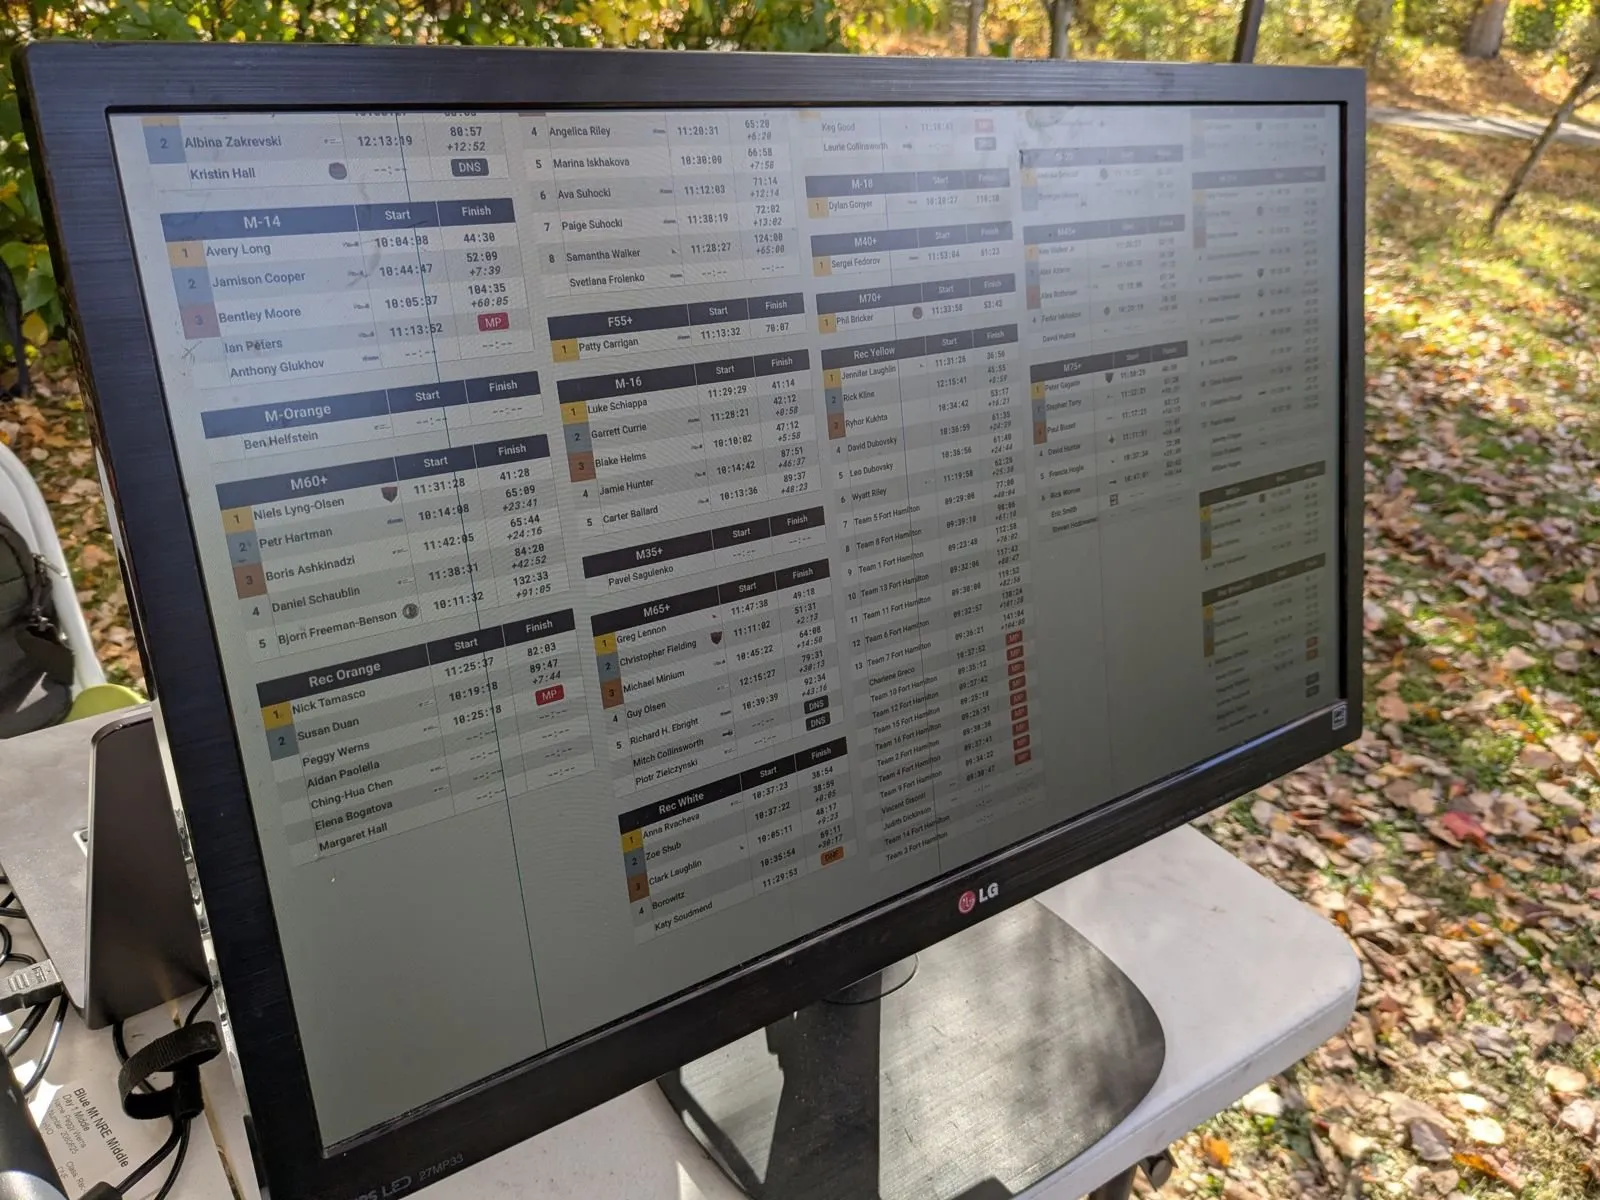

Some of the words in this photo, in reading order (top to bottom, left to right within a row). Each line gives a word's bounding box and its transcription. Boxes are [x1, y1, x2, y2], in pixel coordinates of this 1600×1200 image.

[550, 127, 588, 137] Angelica
[590, 126, 611, 138] Riley
[185, 136, 222, 149] Albina
[226, 135, 282, 148] Zakrevski
[459, 161, 481, 173] DNS
[554, 158, 584, 168] Marina
[190, 167, 227, 180] Kristin
[231, 168, 256, 179] Hall
[558, 189, 575, 199] Ava
[577, 188, 611, 198] Suhocki
[385, 209, 411, 221] Start
[462, 205, 492, 217] Finish
[244, 216, 281, 229] M-14
[562, 220, 586, 232] Paige
[588, 219, 623, 230] Suhocki
[855, 237, 877, 247] M40+
[206, 244, 239, 258] Avery
[242, 243, 271, 257] Long
[566, 250, 610, 262] Samantha
[612, 248, 640, 260] Walker
[212, 275, 259, 288] Jamison
[263, 271, 306, 287] Cooper
[570, 275, 607, 288] Svetlana
[609, 272, 645, 285] Frolenko
[859, 293, 881, 303] M70+
[218, 309, 262, 324] Bentley
[265, 306, 301, 319] Moore
[485, 317, 502, 328] MP
[608, 316, 633, 328] F55+
[224, 342, 242, 354] Ian
[246, 338, 283, 352] Peters
[579, 341, 603, 353] Patty
[605, 337, 639, 350] Carrigan
[854, 349, 869, 359] Rec
[870, 346, 895, 357] Yellow
[230, 364, 276, 379] Anthony
[280, 358, 324, 373] Glukhov
[616, 376, 642, 390] M-16
[265, 404, 331, 422] M-Orange
[588, 404, 607, 414] Luke
[609, 398, 648, 414] Schiappa
[592, 427, 620, 440] Garrett
[623, 422, 647, 434] Currie
[244, 438, 266, 450] Ben
[269, 430, 318, 447] Helfstein
[848, 441, 865, 452] David
[596, 456, 617, 468] Blake
[620, 452, 647, 464] Helms
[291, 474, 328, 491] M60+
[600, 483, 624, 496] Jamie
[626, 478, 654, 491] Hunter
[254, 506, 282, 520] Niels
[285, 497, 345, 517] Lyng-Olsen
[603, 511, 628, 524] Carter
[630, 504, 658, 518] Ballard
[259, 536, 282, 549] Petr
[285, 527, 333, 544] Hartman
[636, 547, 663, 561] M35+
[266, 568, 294, 582] Boris
[298, 554, 355, 576] Ashkinadzi
[608, 574, 631, 586] Pavel
[272, 597, 305, 613] Daniel
[308, 585, 361, 605] Schaublin
[644, 604, 670, 618] M65+
[310, 609, 397, 639] Freeman-Benson
[526, 619, 553, 633] Finish
[617, 633, 636, 646] Greg
[638, 624, 667, 639] Lennon
[620, 648, 666, 668] Christopher
[668, 640, 697, 657] Fielding
[309, 672, 334, 688] Rec
[337, 661, 381, 682] Orange
[624, 678, 654, 693] Michael
[656, 670, 685, 685] Minium
[292, 701, 316, 714] Nick
[318, 688, 366, 708] Tamasco
[541, 689, 557, 701] MP
[627, 707, 642, 720] Guy
[644, 702, 666, 715] Olsen
[809, 700, 824, 710] DNS
[298, 726, 330, 741] Susan
[333, 717, 360, 732] Duan
[811, 717, 826, 727] DNS
[630, 730, 659, 745] Richard
[660, 726, 670, 736] H.
[672, 717, 698, 734] Ebright
[302, 750, 335, 768] Peggy
[338, 741, 370, 757] Werns
[633, 754, 656, 768] Mitch
[658, 738, 704, 761] Collinsworth
[307, 773, 337, 788] Aidan
[636, 773, 654, 786] Piotr
[311, 787, 365, 810] Ching-Hua
[368, 777, 393, 794] Chen
[659, 801, 676, 814] Rec
[678, 792, 704, 808] White
[315, 815, 343, 830] Elena
[346, 800, 393, 823] Bogatova
[319, 830, 365, 852] Margaret
[368, 822, 388, 838] Hall
[643, 826, 663, 839] Anna
[646, 850, 661, 861] Zoe
[662, 841, 682, 856] Shub
[649, 872, 669, 886] Clark
[670, 860, 702, 879] Laughlin
[652, 891, 685, 910] Borowitz
[979, 883, 999, 902] LG
[656, 918, 672, 932] Katy
[63, 1094, 74, 1108] Day
[75, 1111, 90, 1132] Middle
[74, 1088, 90, 1106] Blue
[87, 1107, 97, 1119] Mt
[94, 1116, 112, 1138] NRE
[106, 1138, 128, 1168] Middle
[382, 1175, 413, 1198] LED
[419, 1153, 464, 1181] 27MP33
